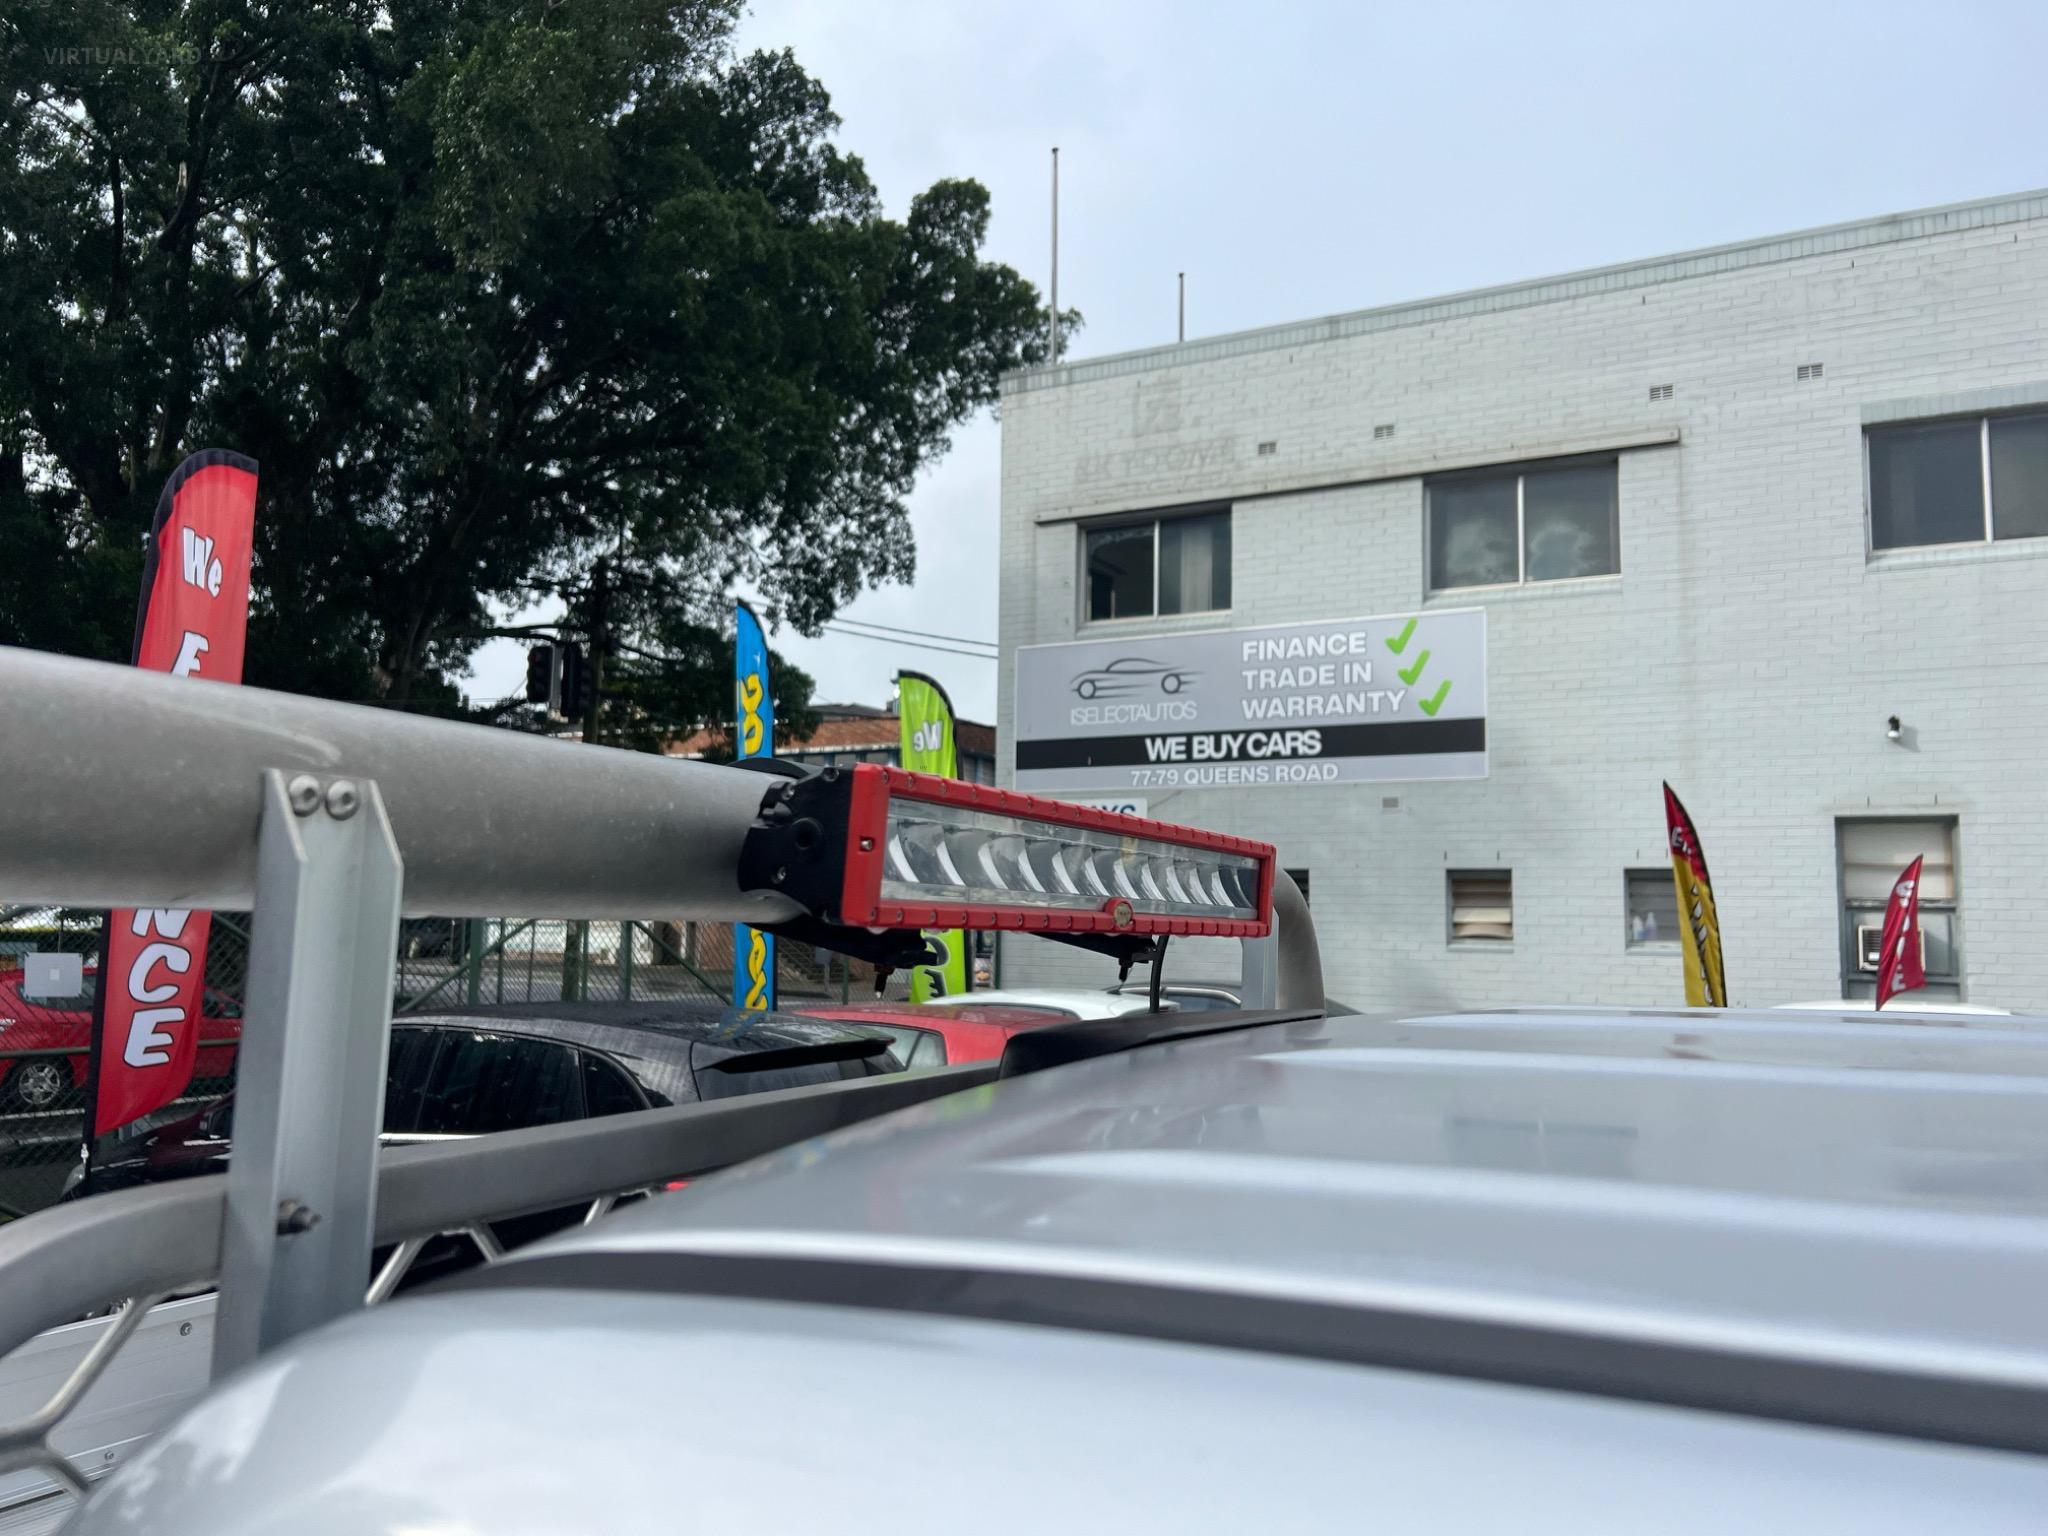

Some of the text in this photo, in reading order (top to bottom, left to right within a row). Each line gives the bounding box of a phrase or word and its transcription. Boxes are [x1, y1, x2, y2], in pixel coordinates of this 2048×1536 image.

[182, 525, 224, 599] We
[1242, 631, 1367, 662] FINANCE
[1242, 661, 1373, 690] TRADE IN
[1242, 689, 1406, 720] WARRANTY
[1145, 729, 1323, 764] WE BUY CARS
[1130, 763, 1339, 787] 77-79 QUEENS ROAD
